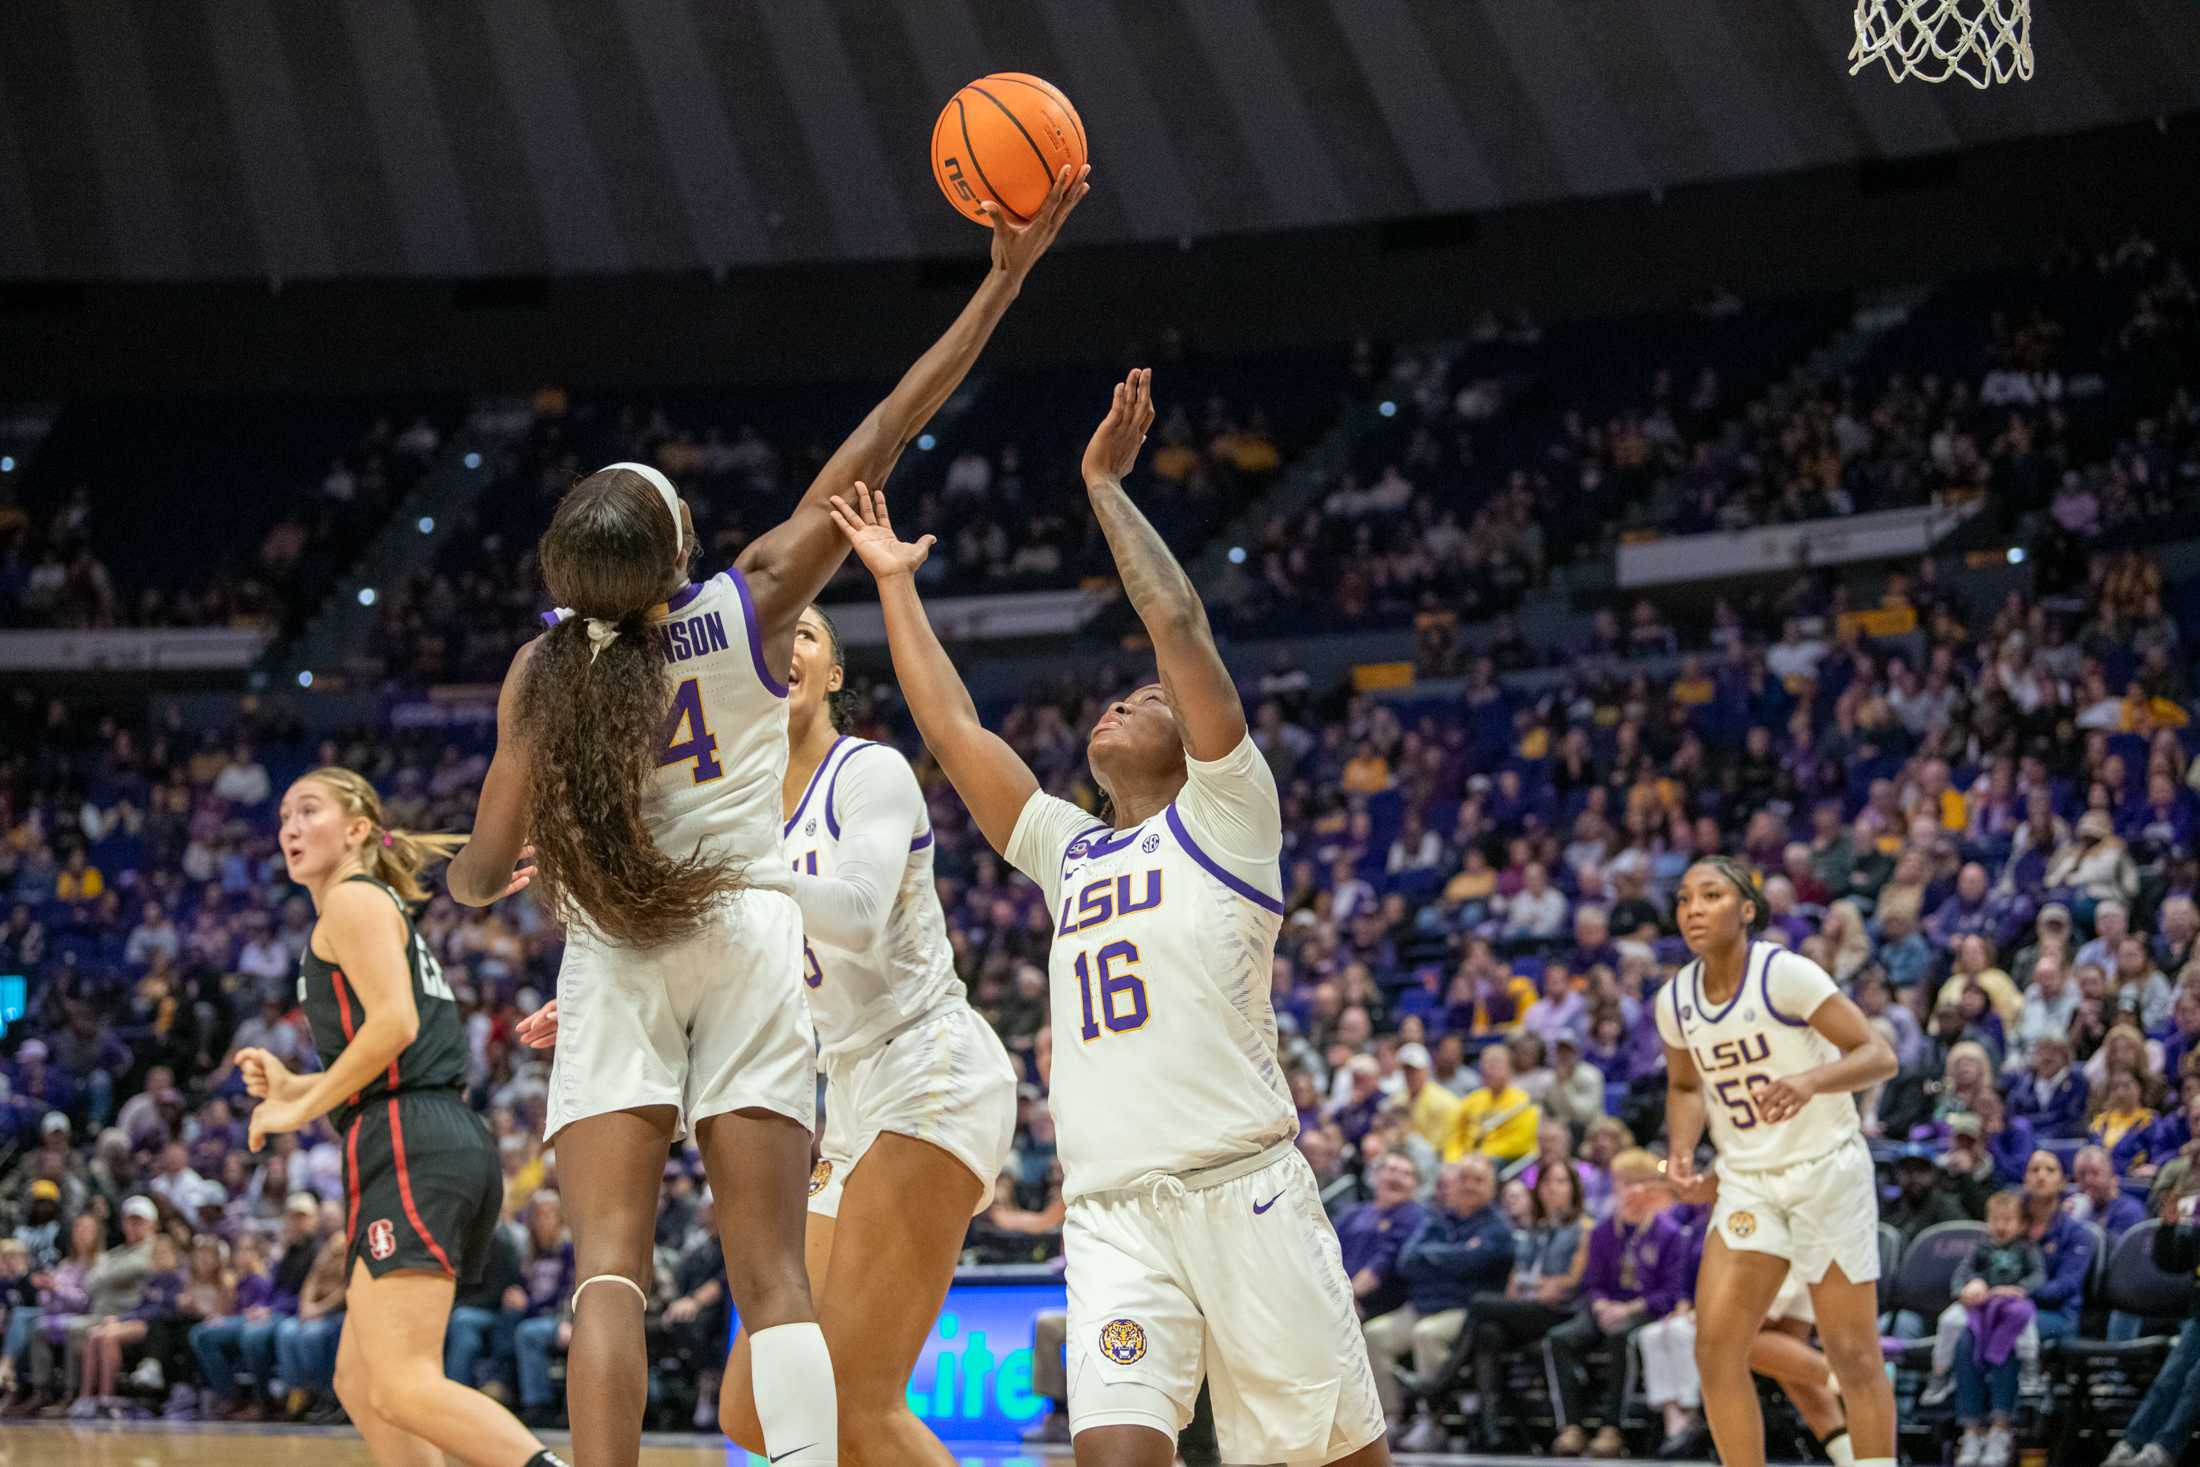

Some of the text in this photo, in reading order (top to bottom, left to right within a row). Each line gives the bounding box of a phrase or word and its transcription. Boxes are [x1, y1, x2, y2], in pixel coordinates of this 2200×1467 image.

[655, 676, 725, 784] 4
[1057, 868, 1164, 940] LSU
[1074, 939, 1151, 1044] 16
[1694, 1032, 1771, 1073] LSU
